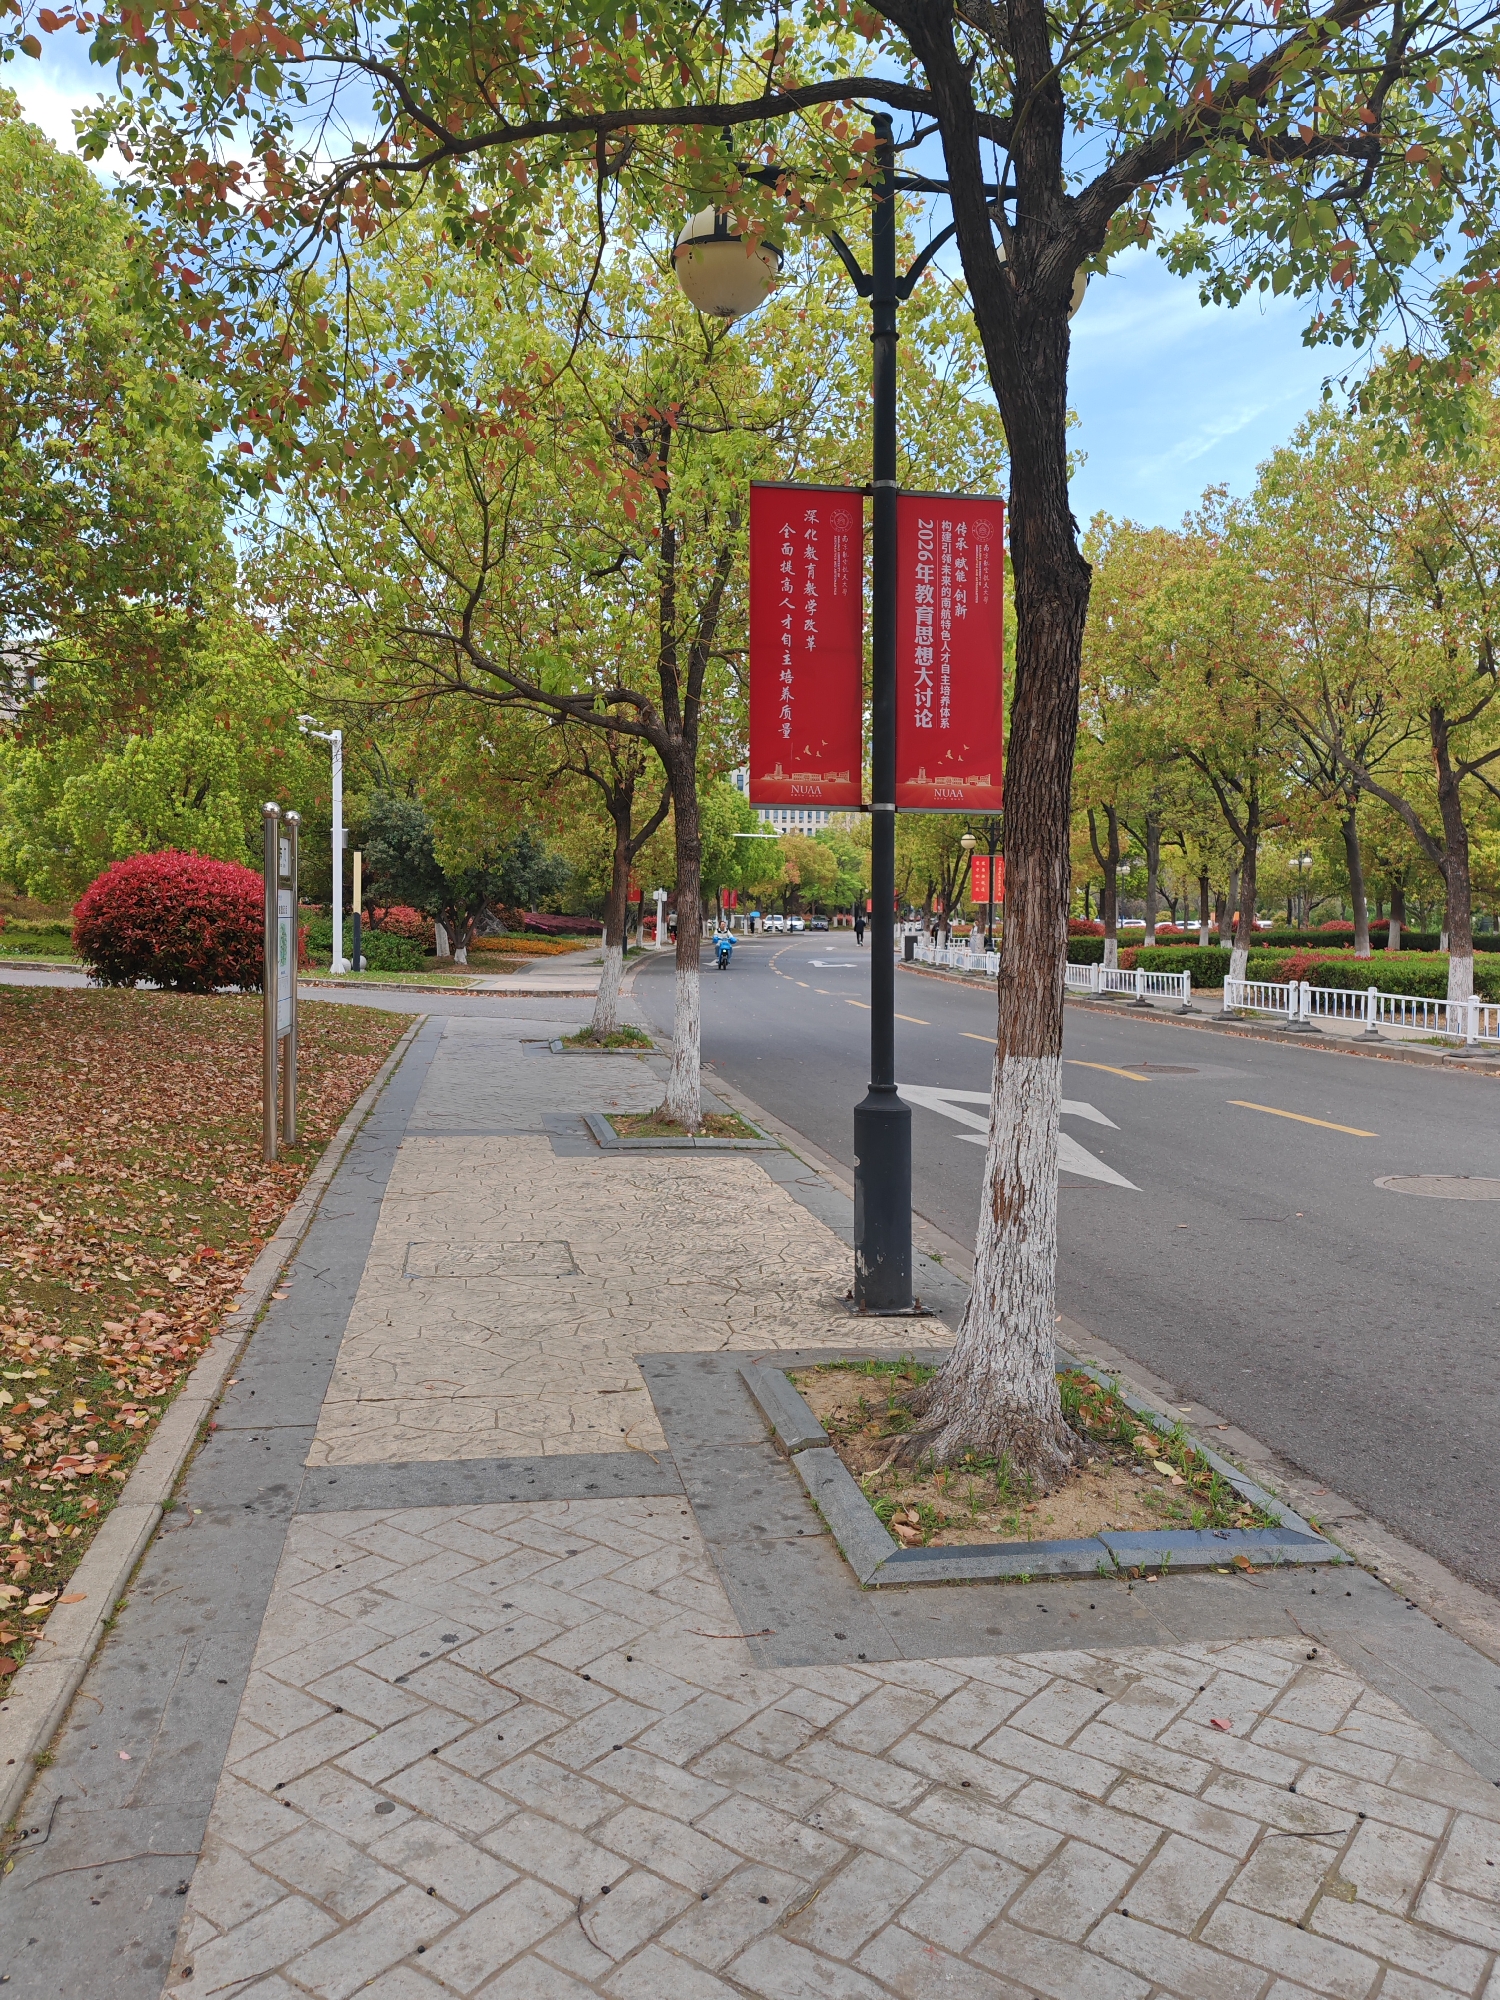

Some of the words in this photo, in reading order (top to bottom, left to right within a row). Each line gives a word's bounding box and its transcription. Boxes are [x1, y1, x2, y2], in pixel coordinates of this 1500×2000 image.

[777, 522, 797, 739] 全面提高人才自主培养质量
[803, 509, 820, 652] 深化教育教学改革
[913, 518, 935, 729] 2026年教育思想大讨论
[939, 519, 952, 729] 构建引领未来的南航特色人才自主培养体系
[791, 784, 822, 795] NUAA
[934, 788, 964, 798] NUAA
